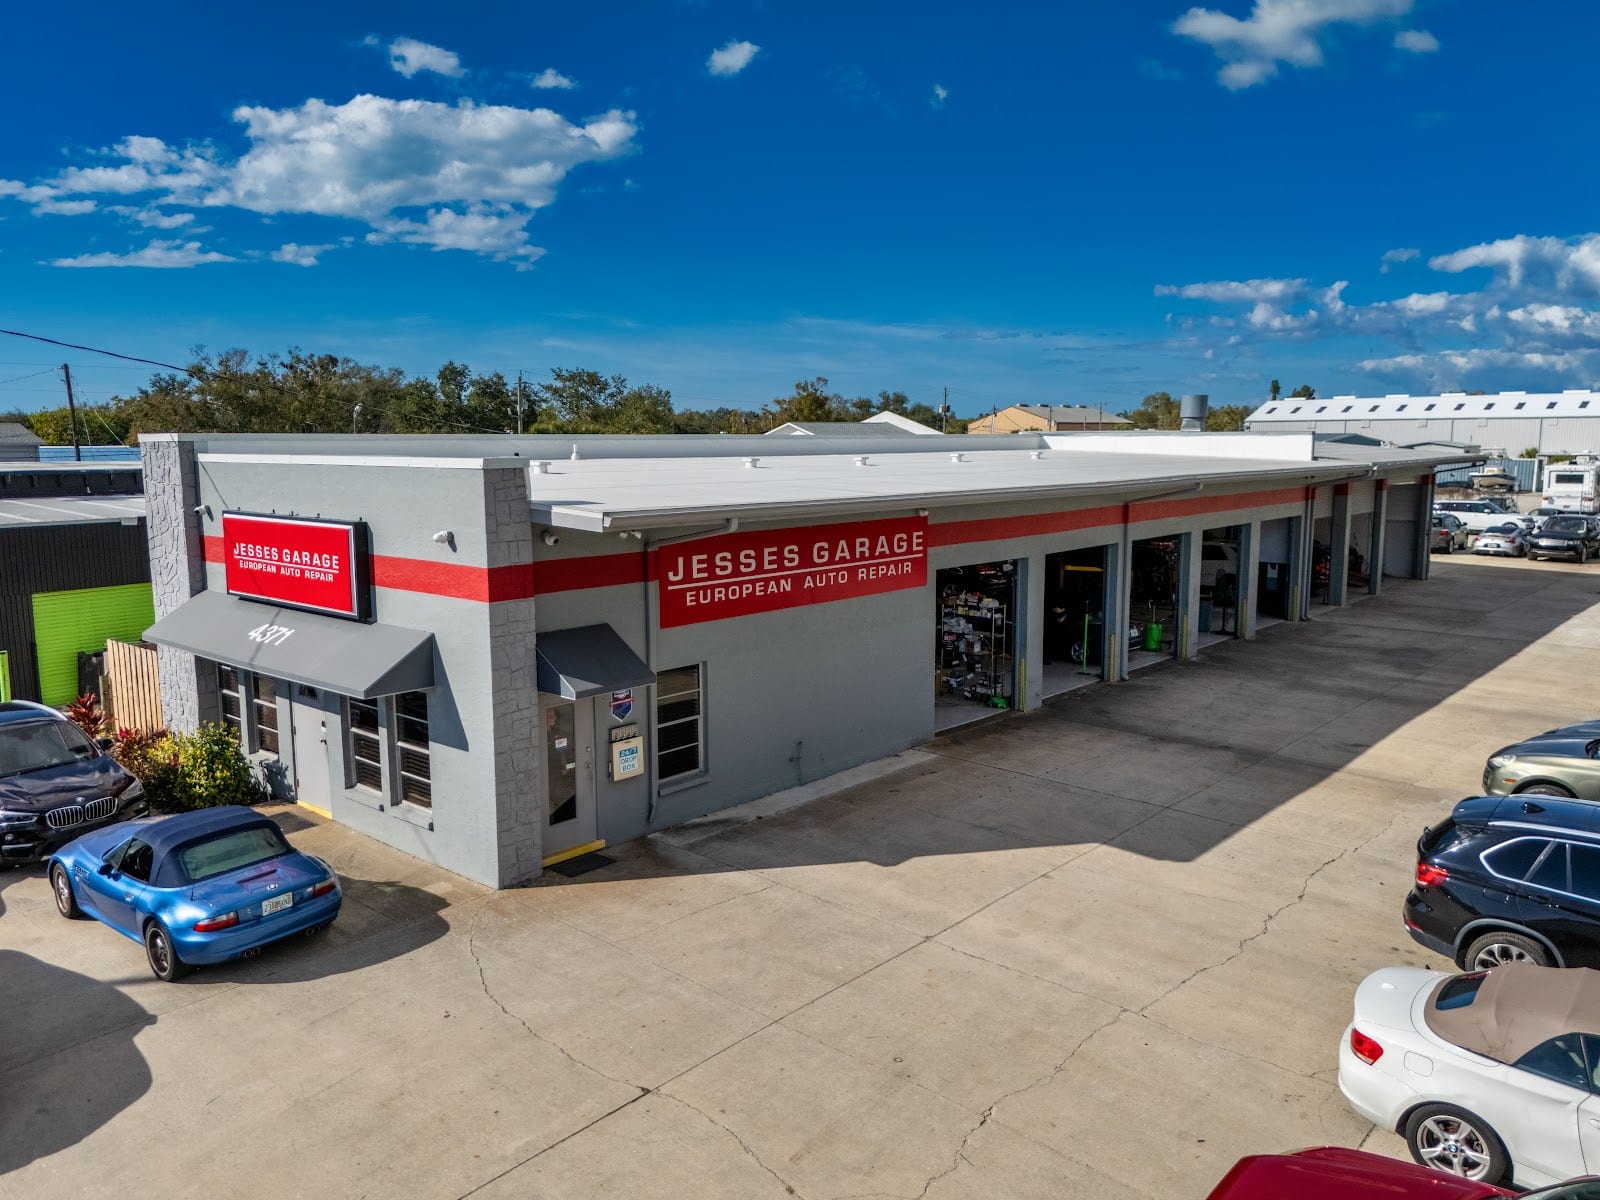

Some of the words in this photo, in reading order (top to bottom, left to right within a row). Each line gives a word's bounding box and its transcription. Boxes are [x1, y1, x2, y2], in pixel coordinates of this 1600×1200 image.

[234, 543, 278, 560] JESSES
[282, 549, 339, 569] GARAGE
[667, 544, 799, 582] JESSES
[812, 531, 924, 564] GARAGE
[240, 560, 276, 573] EUROPEAN
[280, 567, 300, 577] AUTO
[305, 571, 333, 582] REPAIR
[686, 578, 792, 607] EUROPEAN
[803, 571, 848, 589] AUTO
[858, 561, 912, 581] REPAIR
[248, 623, 295, 646] 4371
[620, 755, 637, 765] DROP
[622, 763, 636, 772] BOX
